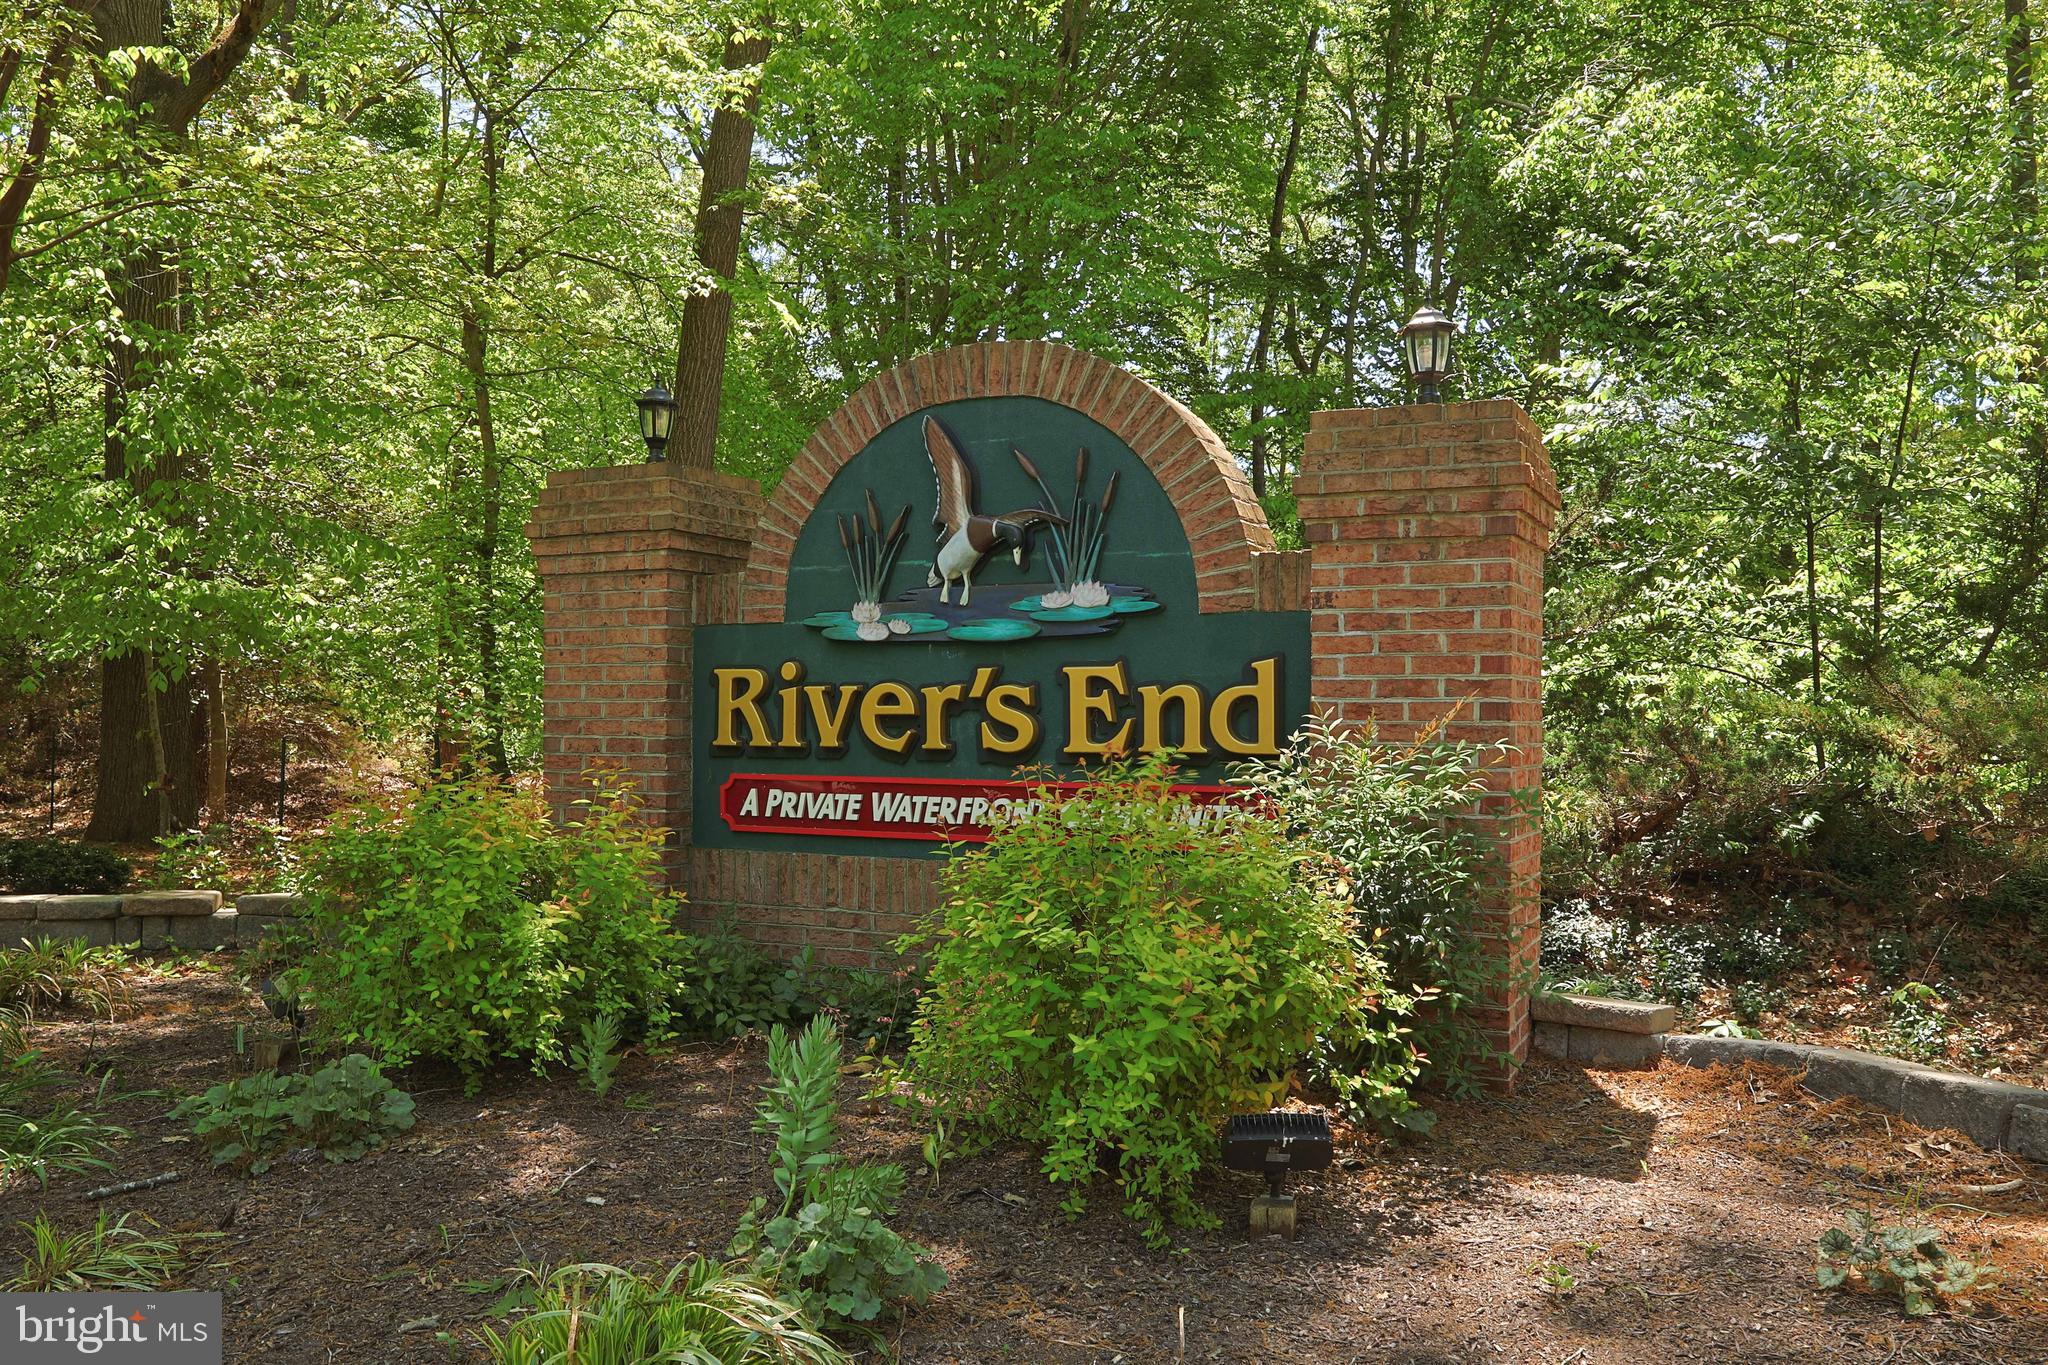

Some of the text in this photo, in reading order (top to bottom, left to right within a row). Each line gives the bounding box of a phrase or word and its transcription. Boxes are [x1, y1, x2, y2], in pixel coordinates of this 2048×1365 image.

[712, 658, 1281, 757] River's End
[740, 788, 759, 817] A
[764, 788, 864, 822] PRIVATE
